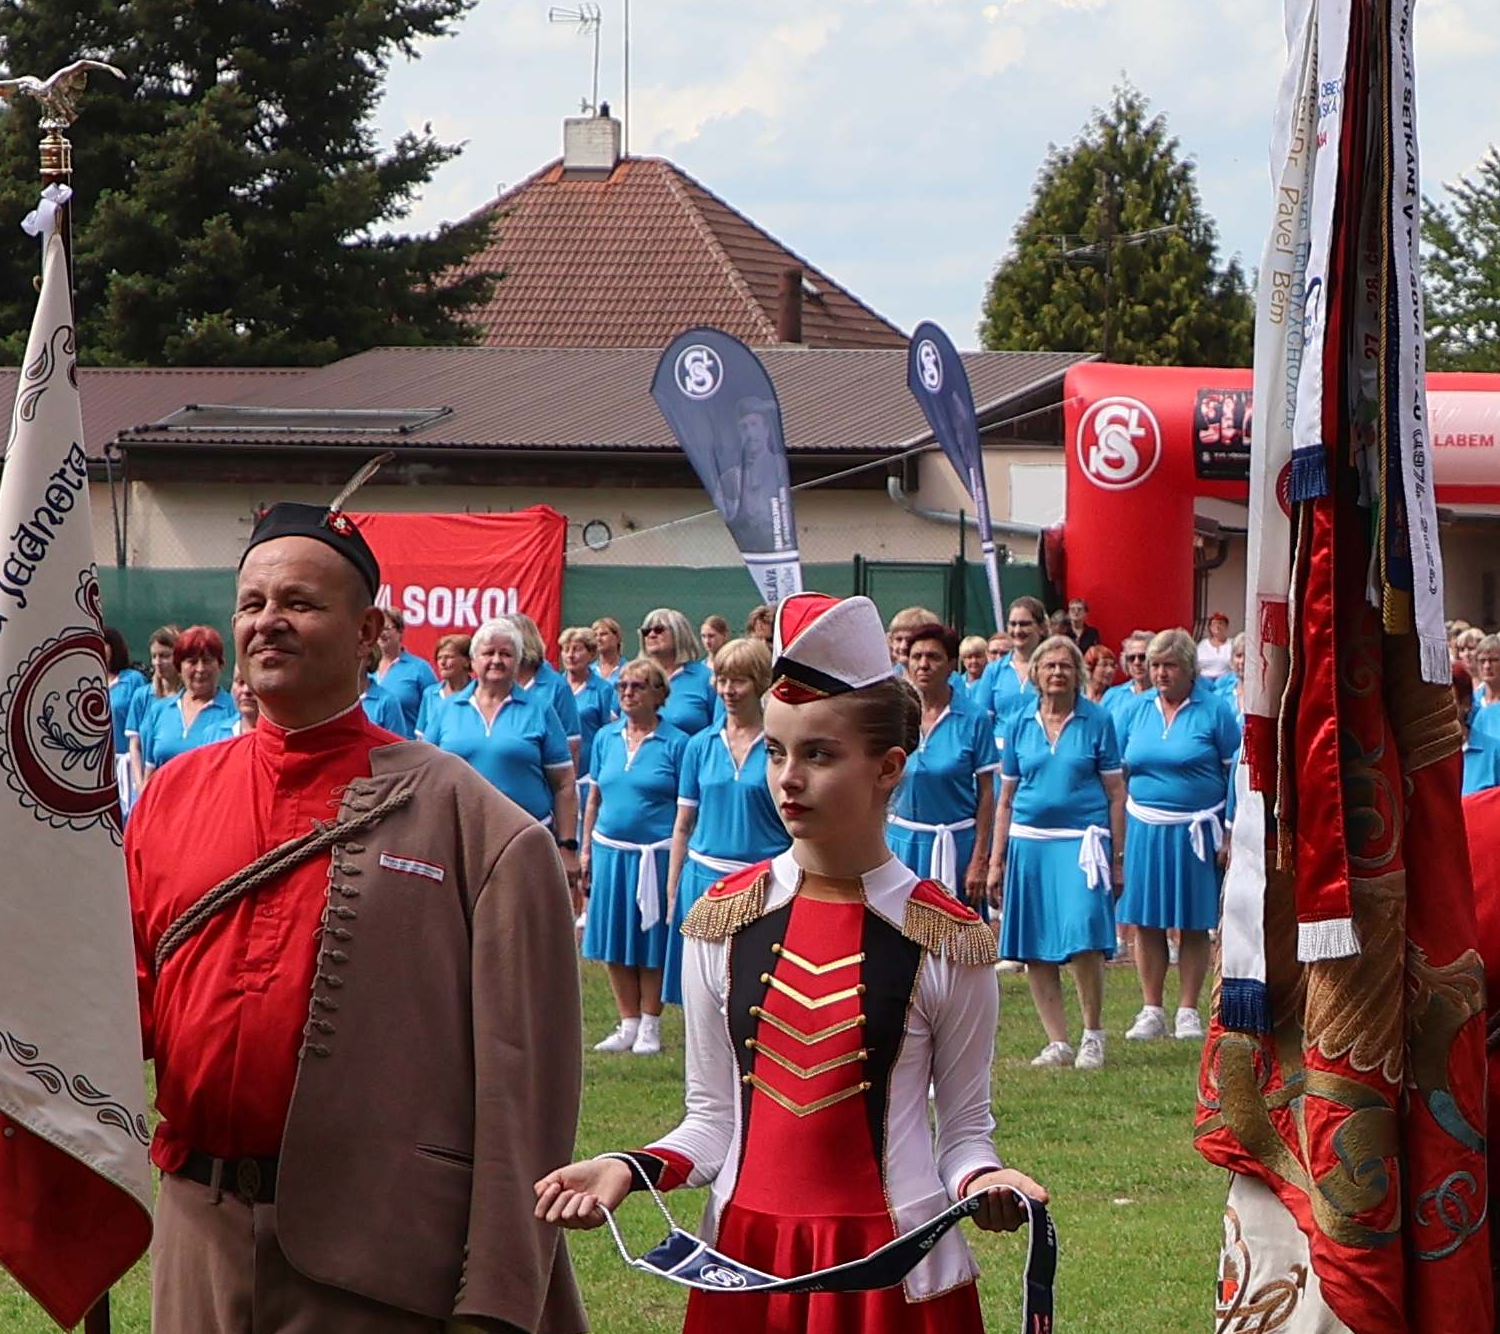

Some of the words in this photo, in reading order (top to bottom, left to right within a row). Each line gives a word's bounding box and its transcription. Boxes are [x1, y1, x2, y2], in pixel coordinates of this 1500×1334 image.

[1402, 87, 1416, 197] SETKÁNÍ
[1276, 186, 1301, 255] Pavel
[1269, 271, 1292, 326] Bém
[1433, 434, 1494, 448] LABEM
